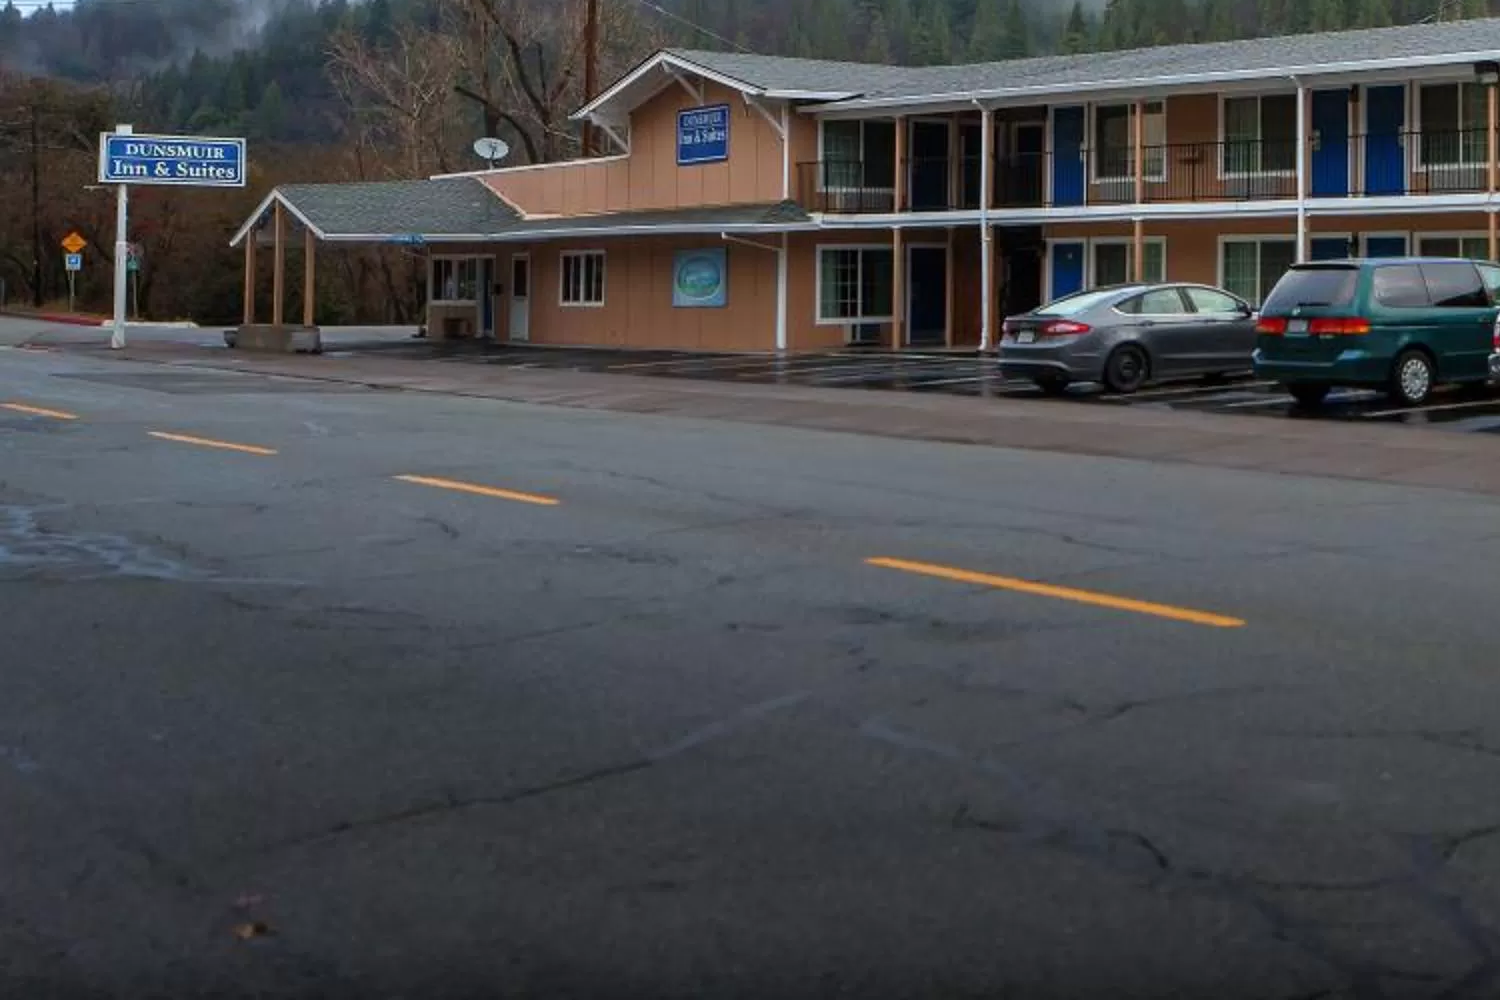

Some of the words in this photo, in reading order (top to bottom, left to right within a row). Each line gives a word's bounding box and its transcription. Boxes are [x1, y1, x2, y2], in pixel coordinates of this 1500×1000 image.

[126, 143, 225, 159] DUNSMUIR
[114, 160, 148, 175] Inn
[155, 161, 171, 176] &
[176, 161, 235, 179] Suites
